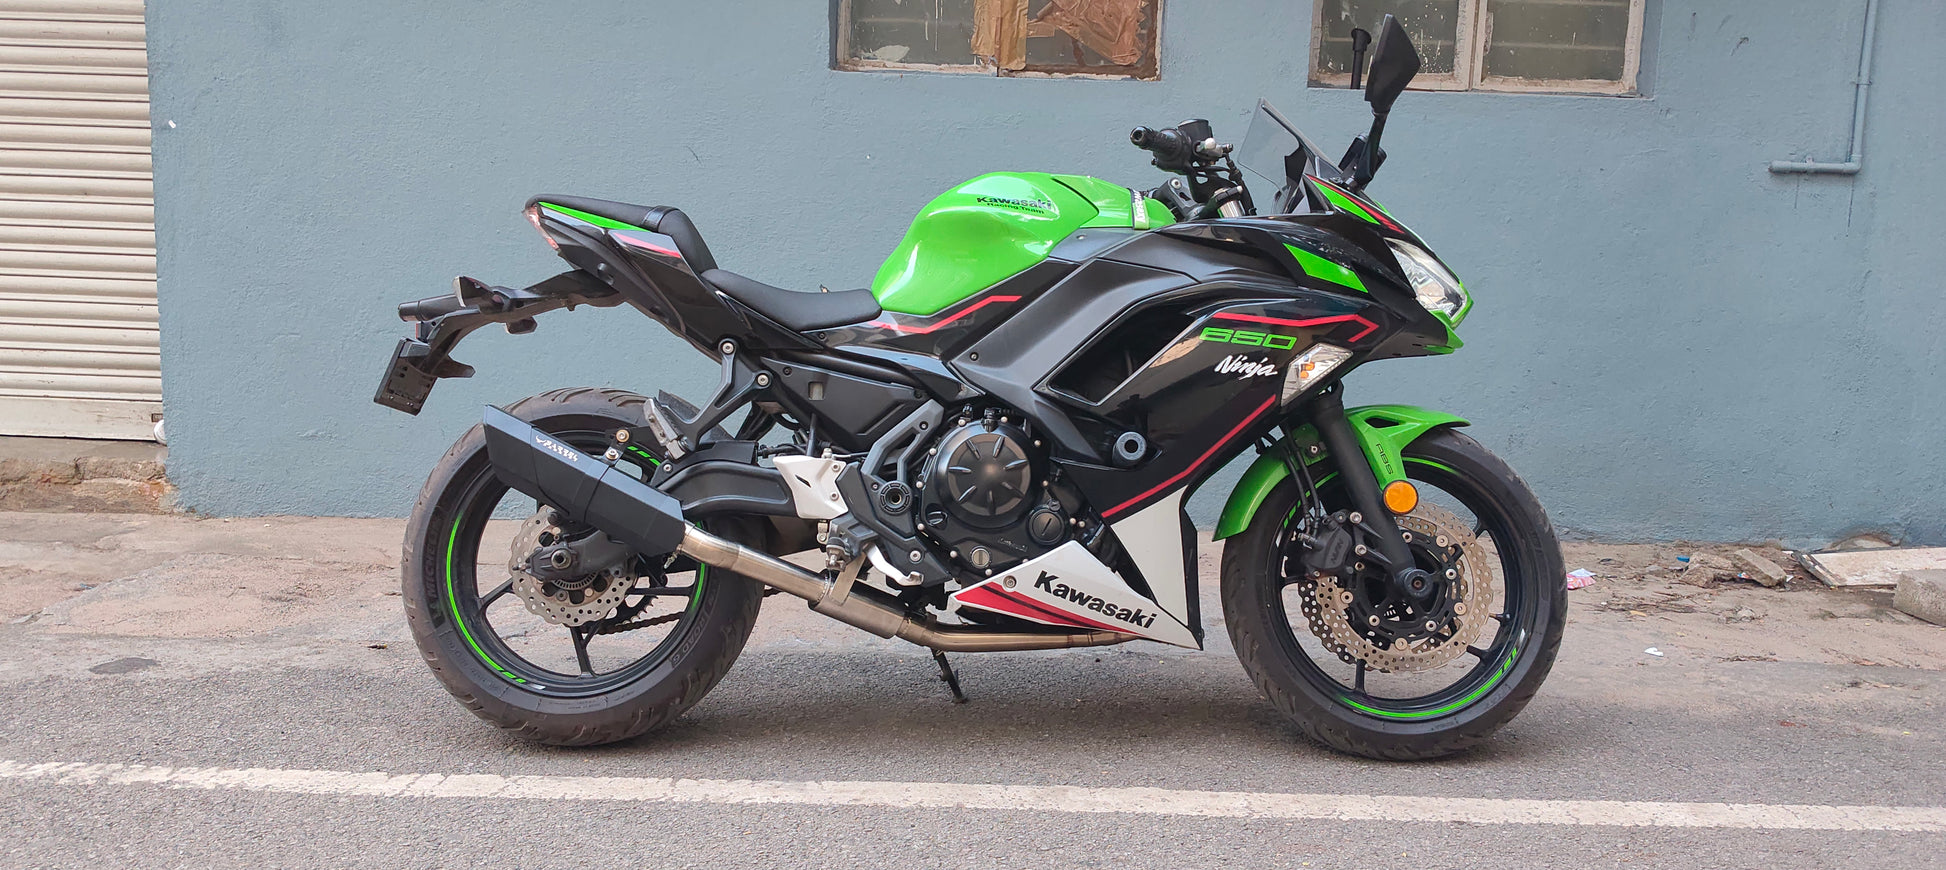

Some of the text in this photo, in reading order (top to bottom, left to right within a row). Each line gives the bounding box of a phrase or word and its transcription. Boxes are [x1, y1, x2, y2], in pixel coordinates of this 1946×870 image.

[976, 196, 1052, 210] Kawasaki
[986, 202, 1045, 214] Racing Team
[1199, 326, 1297, 350] 650
[1214, 354, 1278, 380] Ninja
[1375, 443, 1393, 475] ABS
[1033, 570, 1158, 629] Kawasaki
[682, 615, 708, 653] ROAD
